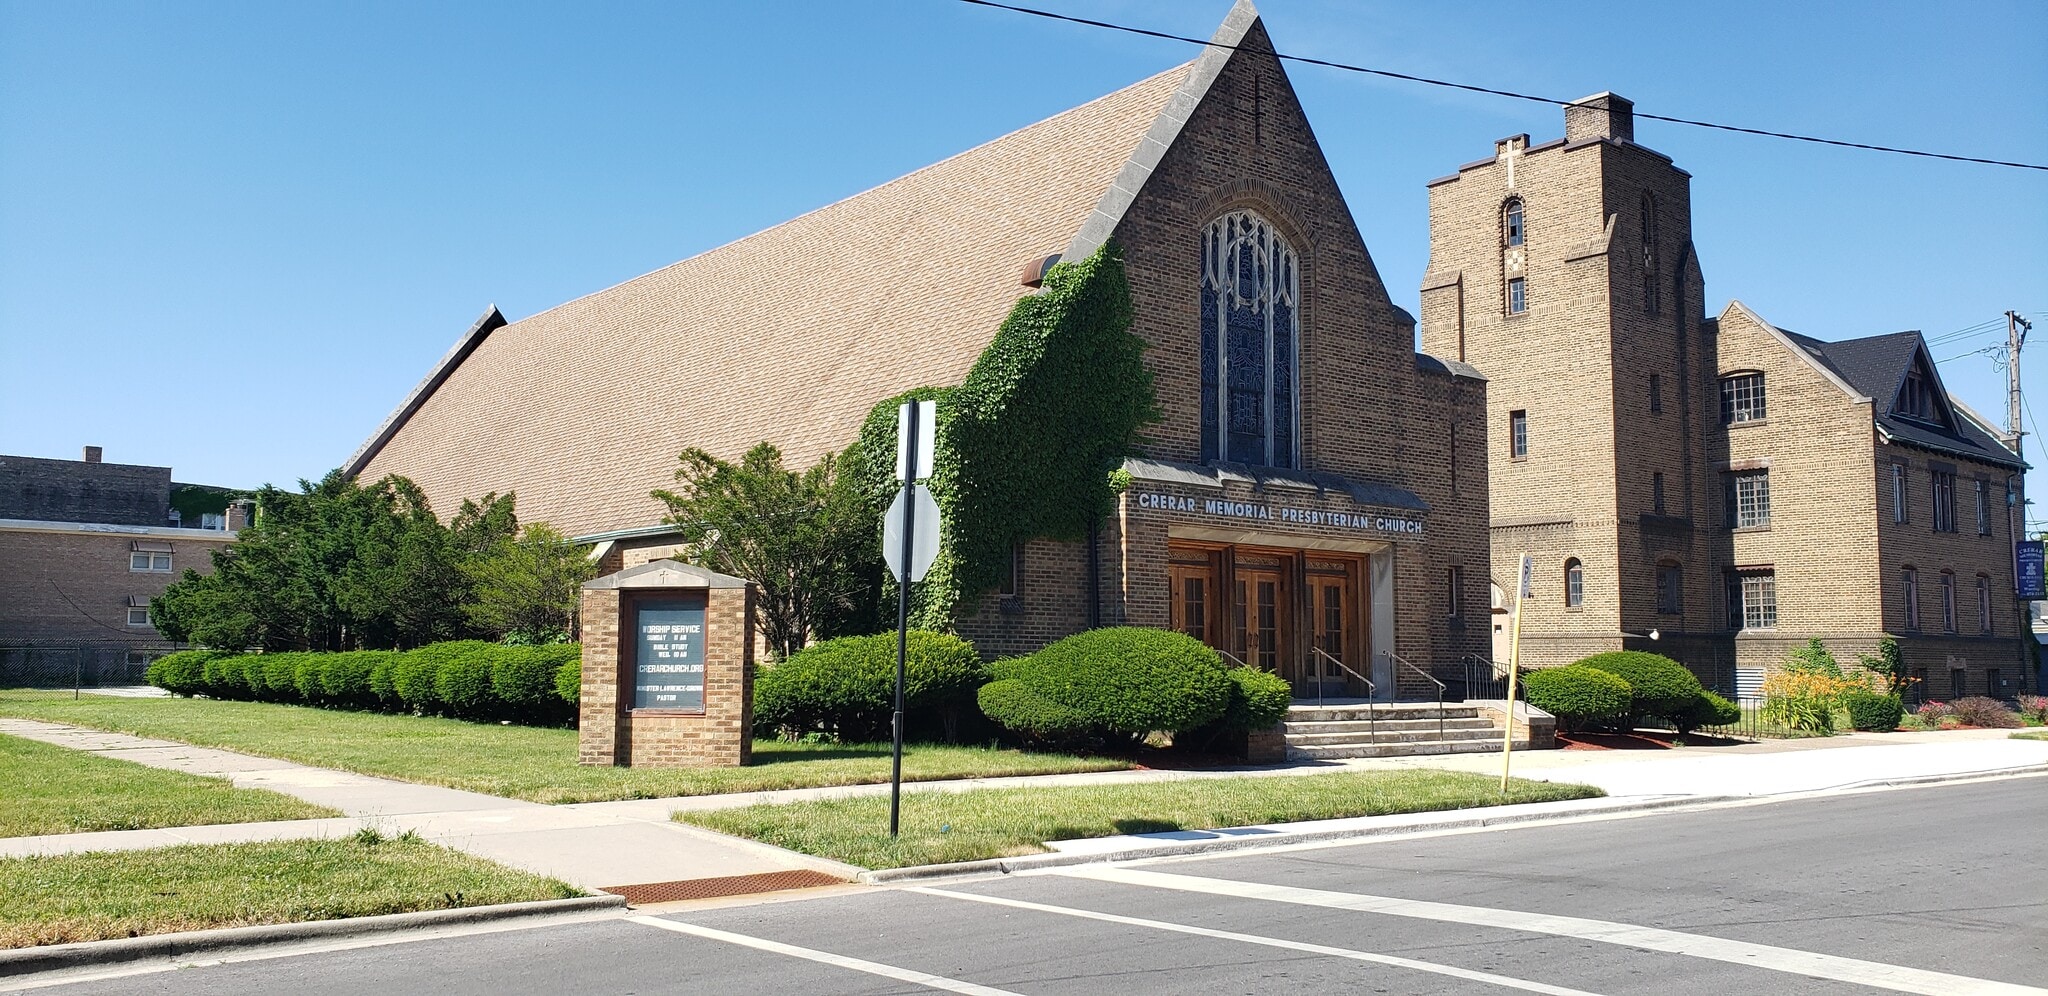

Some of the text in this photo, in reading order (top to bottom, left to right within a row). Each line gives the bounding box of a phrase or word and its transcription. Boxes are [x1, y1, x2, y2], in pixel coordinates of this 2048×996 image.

[1139, 493, 1422, 534] CRERAR MEMORIAL PRESBYTERIAN CHURCH
[642, 625, 701, 634] WORSHIP SERVICE
[653, 643, 669, 651] BIBLE
[639, 664, 704, 673] CRERARCHURCH.ORG
